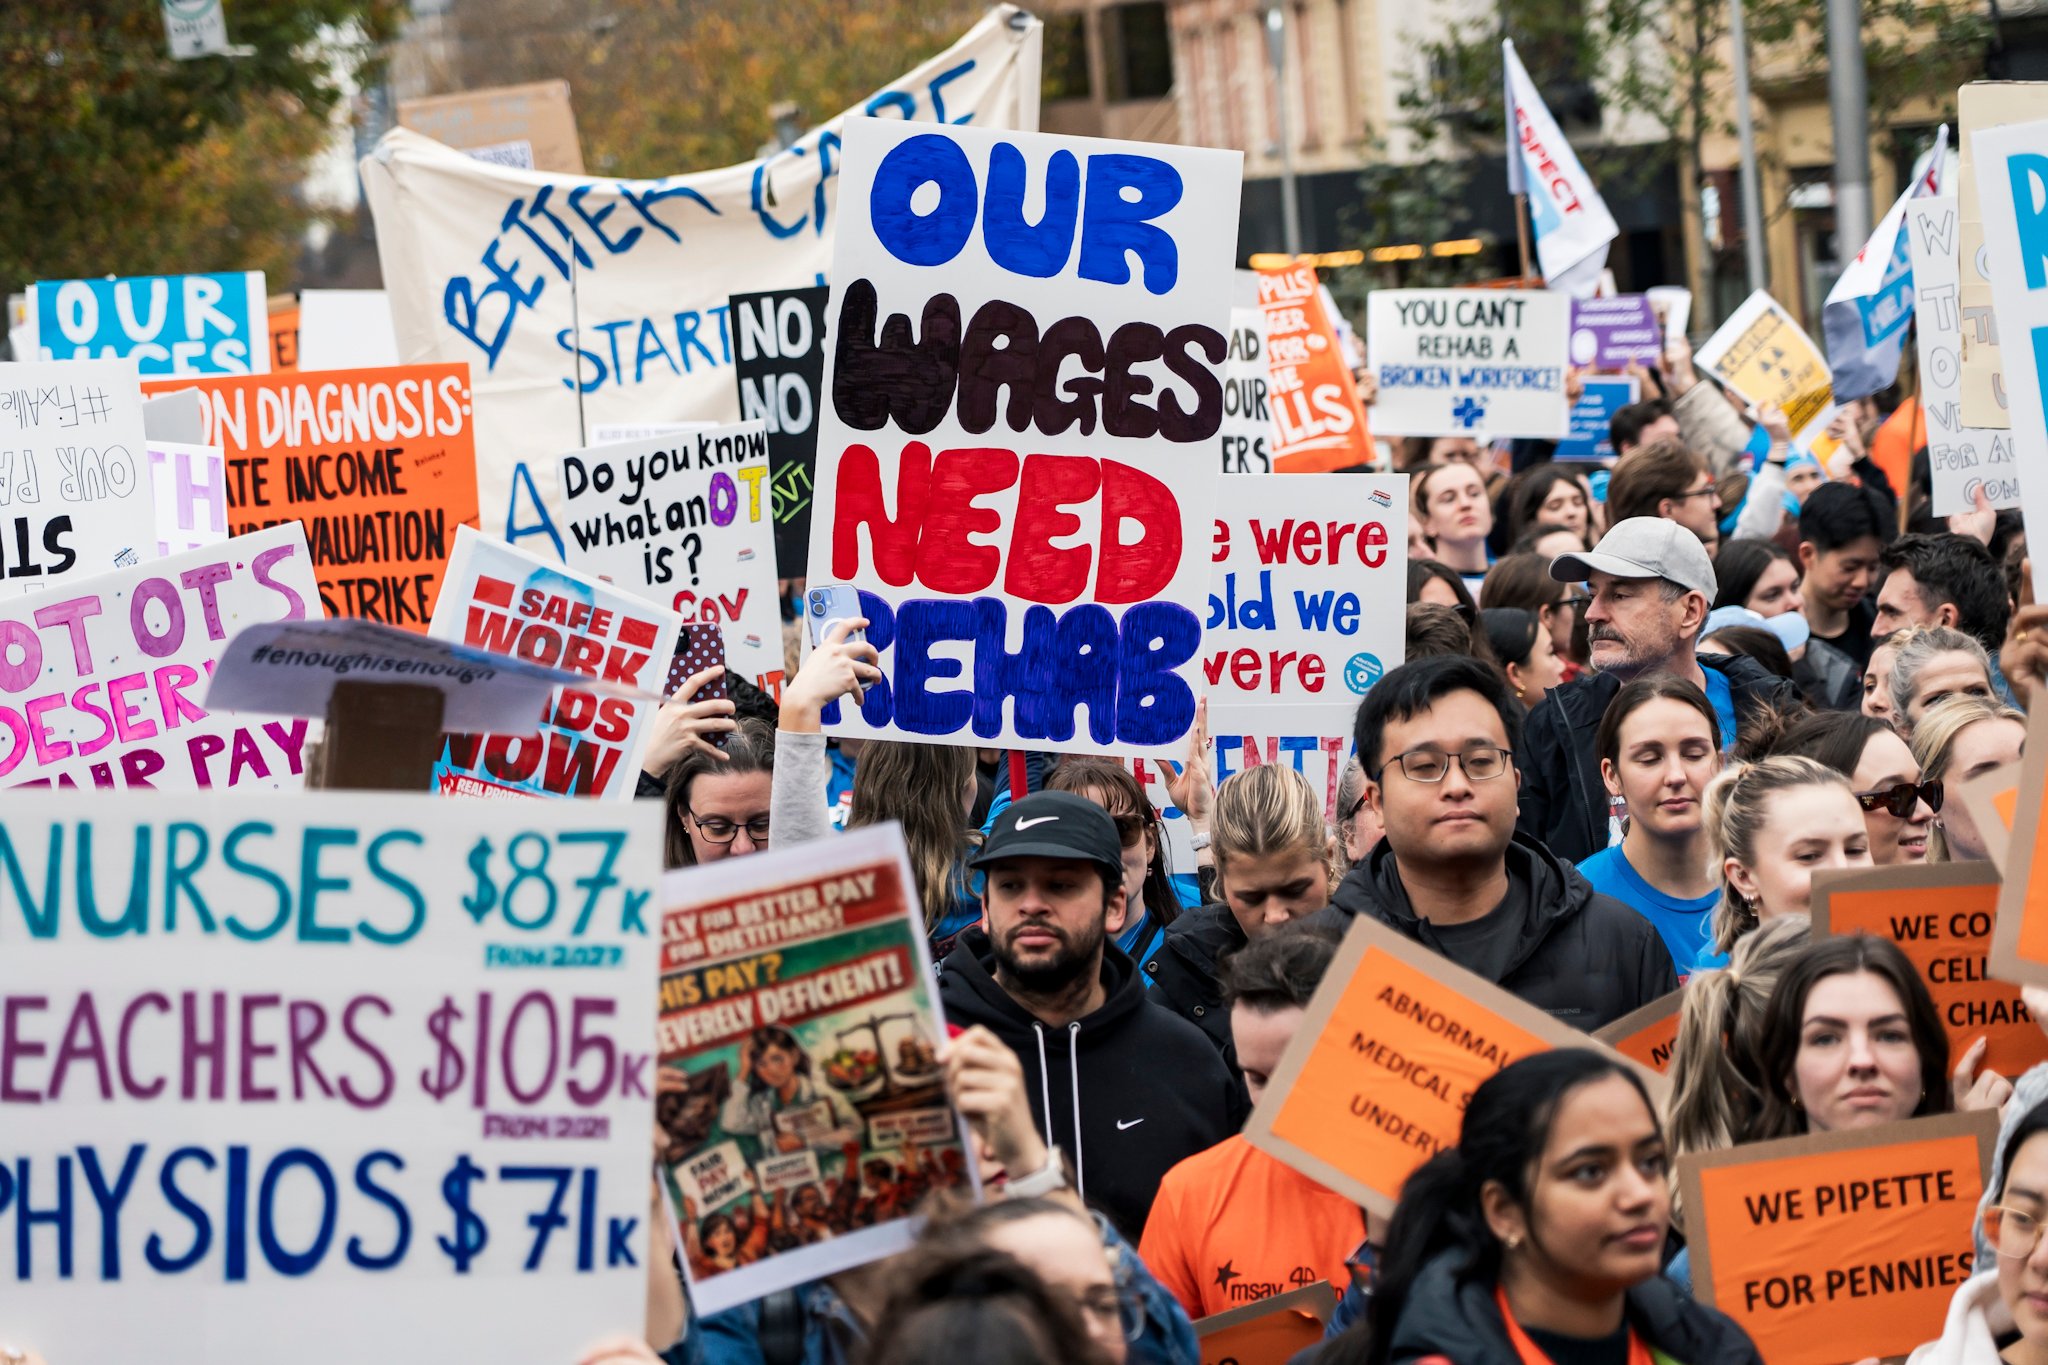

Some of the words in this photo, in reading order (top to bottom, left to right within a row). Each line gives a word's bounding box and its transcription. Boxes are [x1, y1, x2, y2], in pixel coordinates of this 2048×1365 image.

[869, 133, 1184, 295] OUR
[443, 179, 722, 374] BETTER
[56, 276, 237, 344] OUR
[737, 296, 813, 361] NO
[1396, 299, 1447, 327] YOU
[1456, 296, 1525, 328] CAN'T
[833, 279, 1229, 443] WAGES
[1379, 364, 1451, 389] BROKEN
[1417, 335, 1492, 359] REHAB
[1503, 337, 1519, 359] A
[257, 375, 473, 449] DIAGNOSIS:
[740, 372, 813, 435] NO
[1225, 378, 1269, 421] OUR
[56, 444, 136, 502] OUR
[286, 447, 408, 504] INCOME
[564, 456, 615, 500] Do
[619, 445, 691, 506] you
[697, 430, 767, 470] know
[708, 464, 769, 527] OT
[832, 441, 1183, 604] NEED
[1249, 518, 1389, 568] were
[518, 588, 614, 638] SAFE
[1293, 590, 1361, 636] we
[251, 644, 499, 685] #enoughisenough
[463, 605, 651, 689] WORK
[821, 590, 1202, 745] REHAB
[187, 717, 310, 789] PAY
[0, 821, 427, 946] NURSES
[736, 887, 814, 924] BETTER
[821, 871, 877, 908] PAY
[706, 904, 846, 956] DIETITIANS!
[1890, 914, 1939, 941] WE
[1949, 911, 1997, 939] CO
[704, 950, 784, 999] PAY?
[756, 950, 904, 1026] DEFICIENT!
[2, 990, 397, 1110] EACHERS
[1350, 1029, 1452, 1103] MEDICAL
[1744, 1190, 1804, 1226] WE
[1815, 1169, 1957, 1218] PIPETTE
[1744, 1274, 1815, 1313] FOR
[1826, 1251, 1975, 1300] PENNIES
